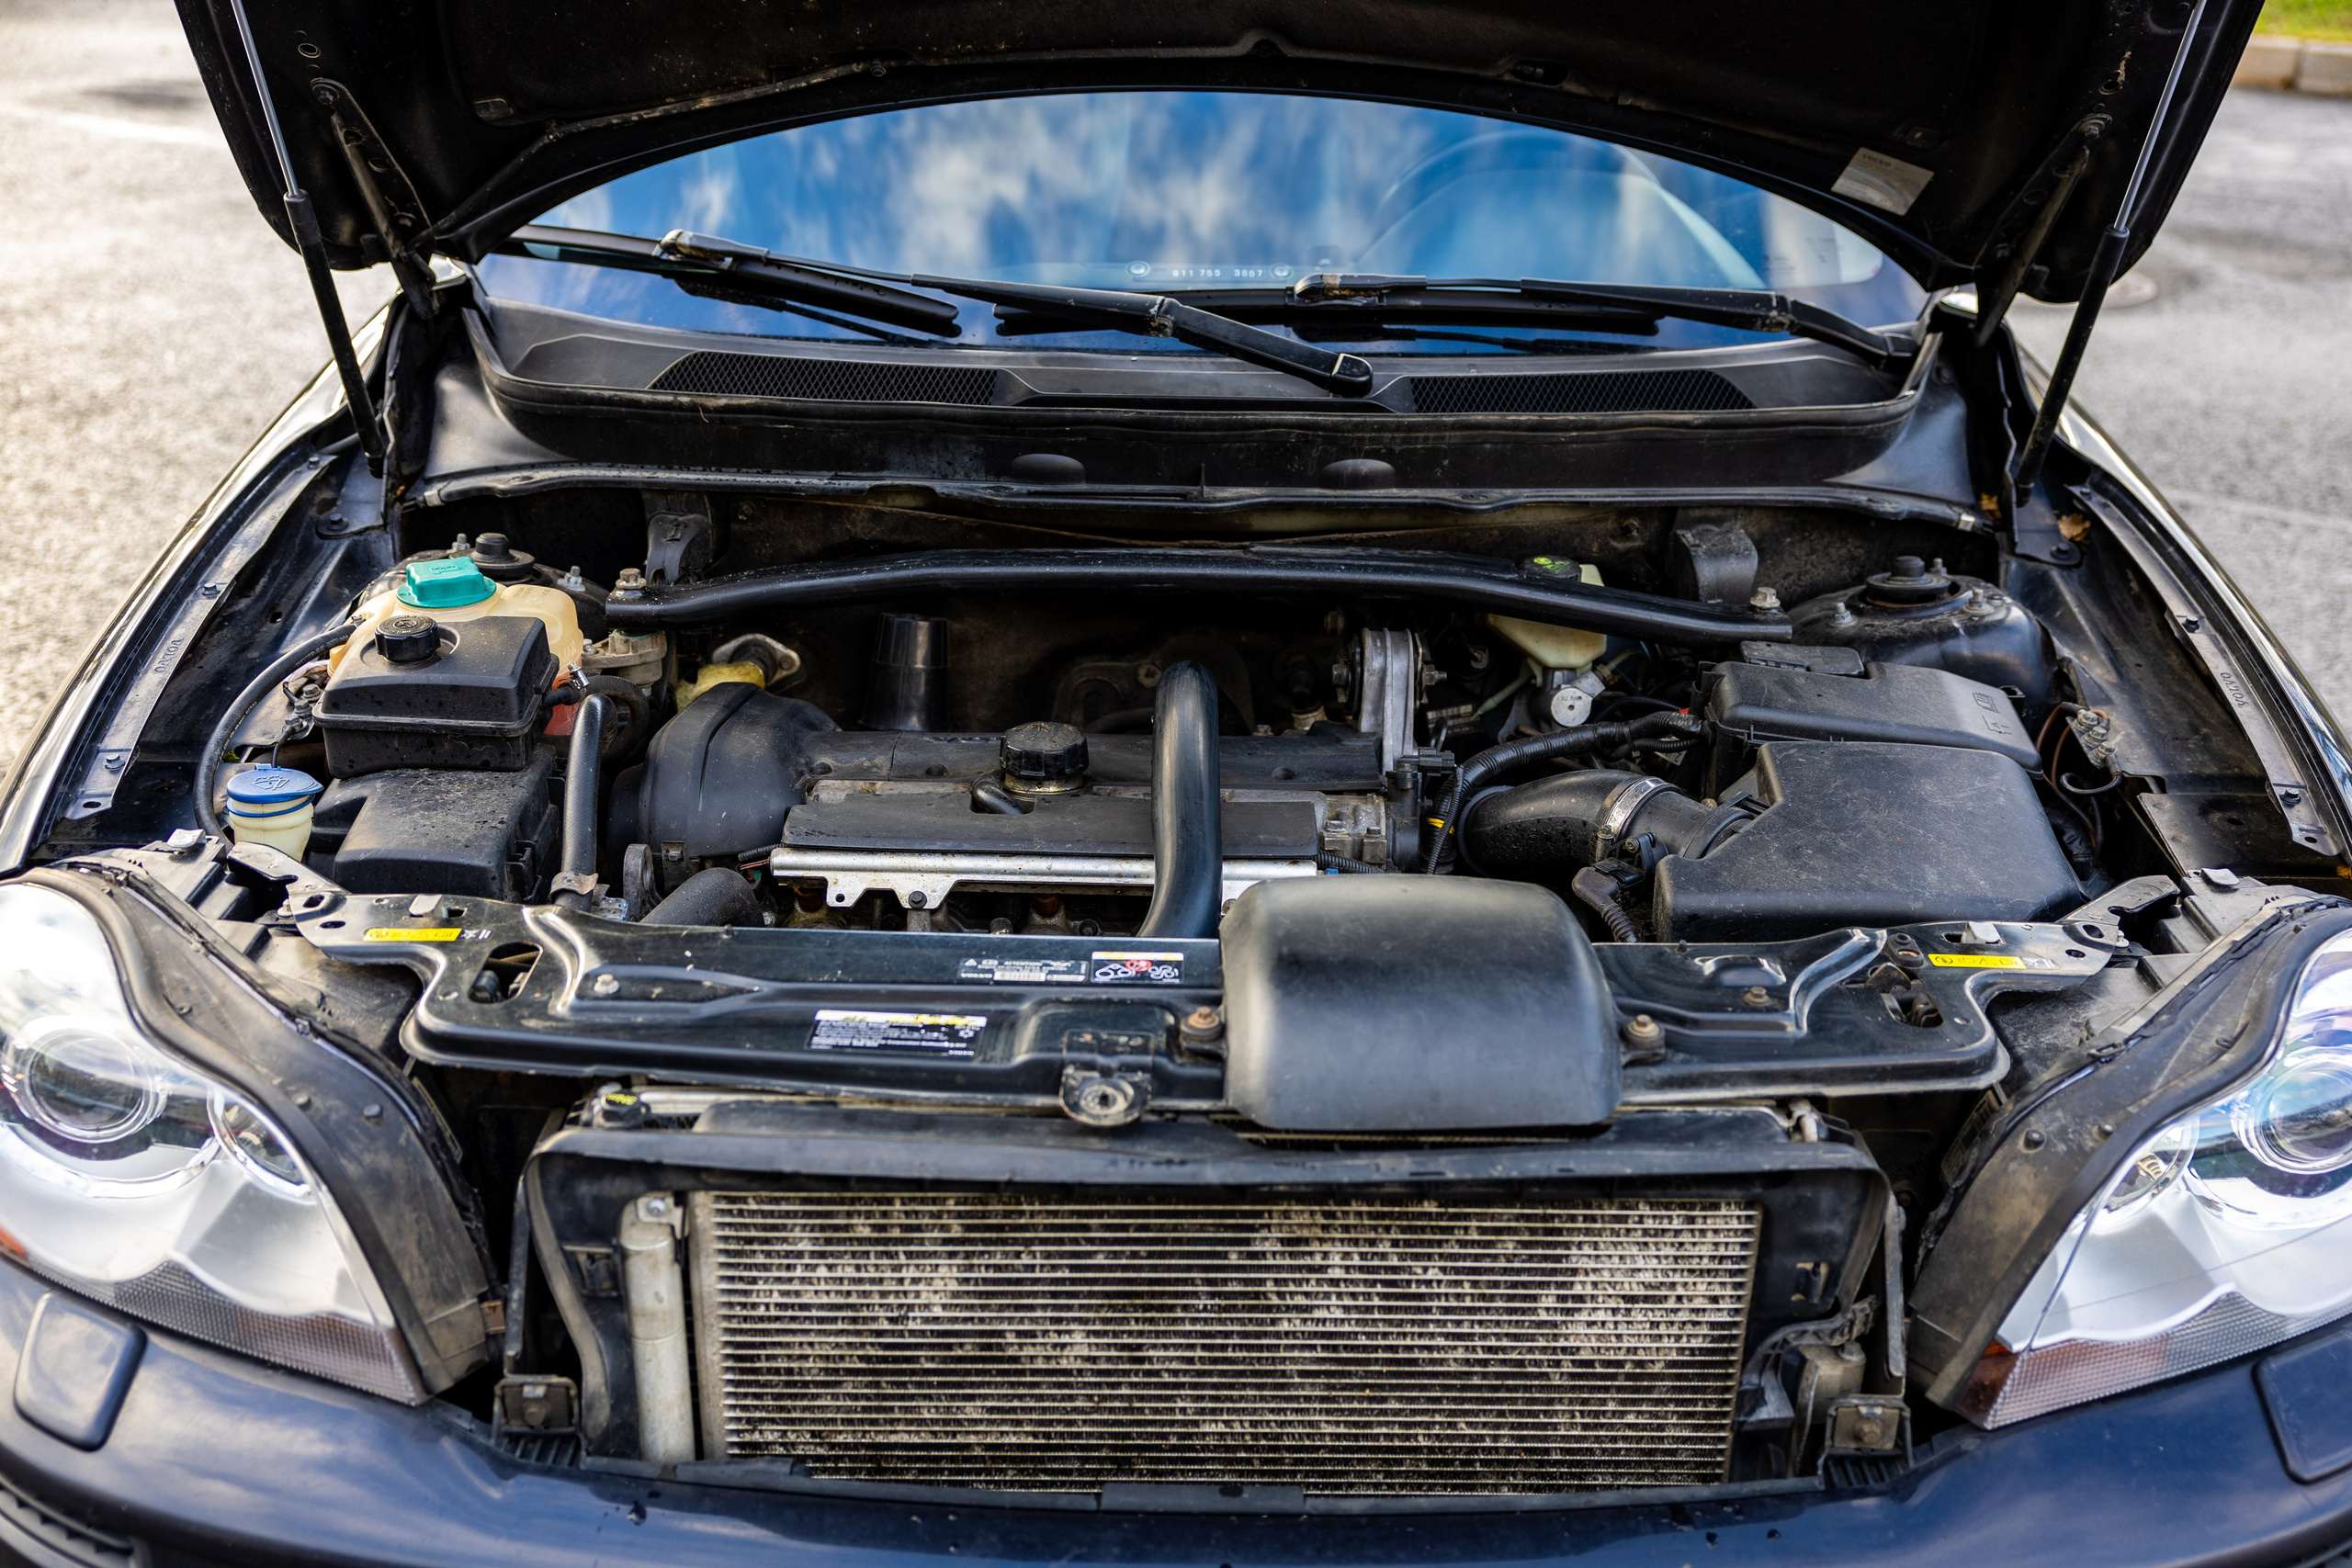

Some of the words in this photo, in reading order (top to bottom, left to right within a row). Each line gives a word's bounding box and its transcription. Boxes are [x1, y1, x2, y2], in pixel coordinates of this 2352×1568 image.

[1861, 152, 1892, 167] VOLVO
[154, 637, 184, 673] VOLVO
[2221, 672, 2249, 708] VOLVO
